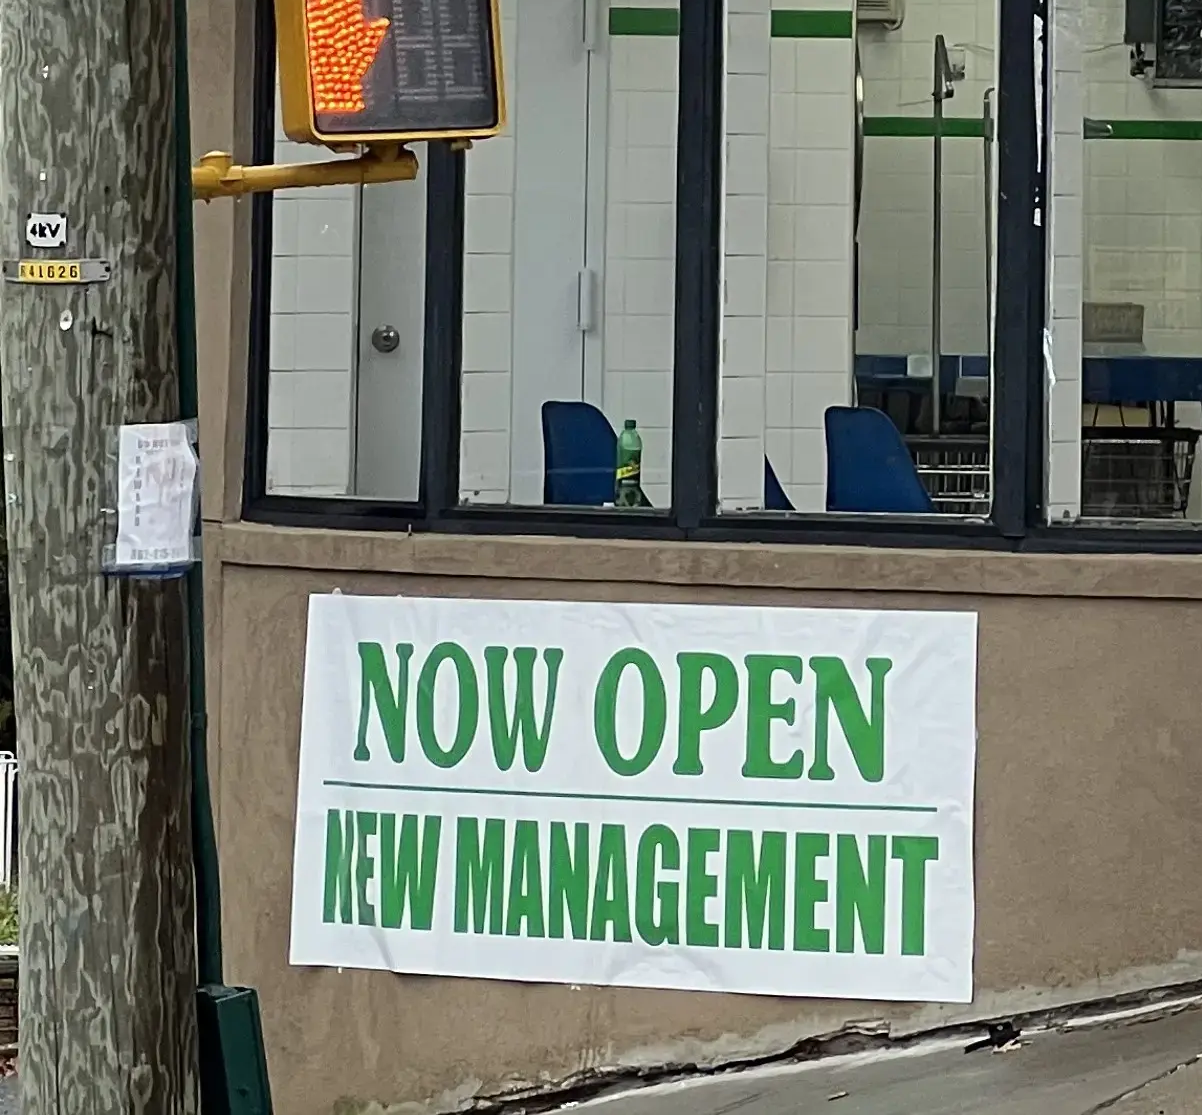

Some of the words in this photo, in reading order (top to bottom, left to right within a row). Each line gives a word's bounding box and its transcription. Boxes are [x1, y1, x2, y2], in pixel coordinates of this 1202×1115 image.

[354, 641, 563, 772] NOW
[594, 647, 893, 781] OPEN
[323, 809, 442, 931] NEW
[453, 816, 939, 956] MANAGEMENT
